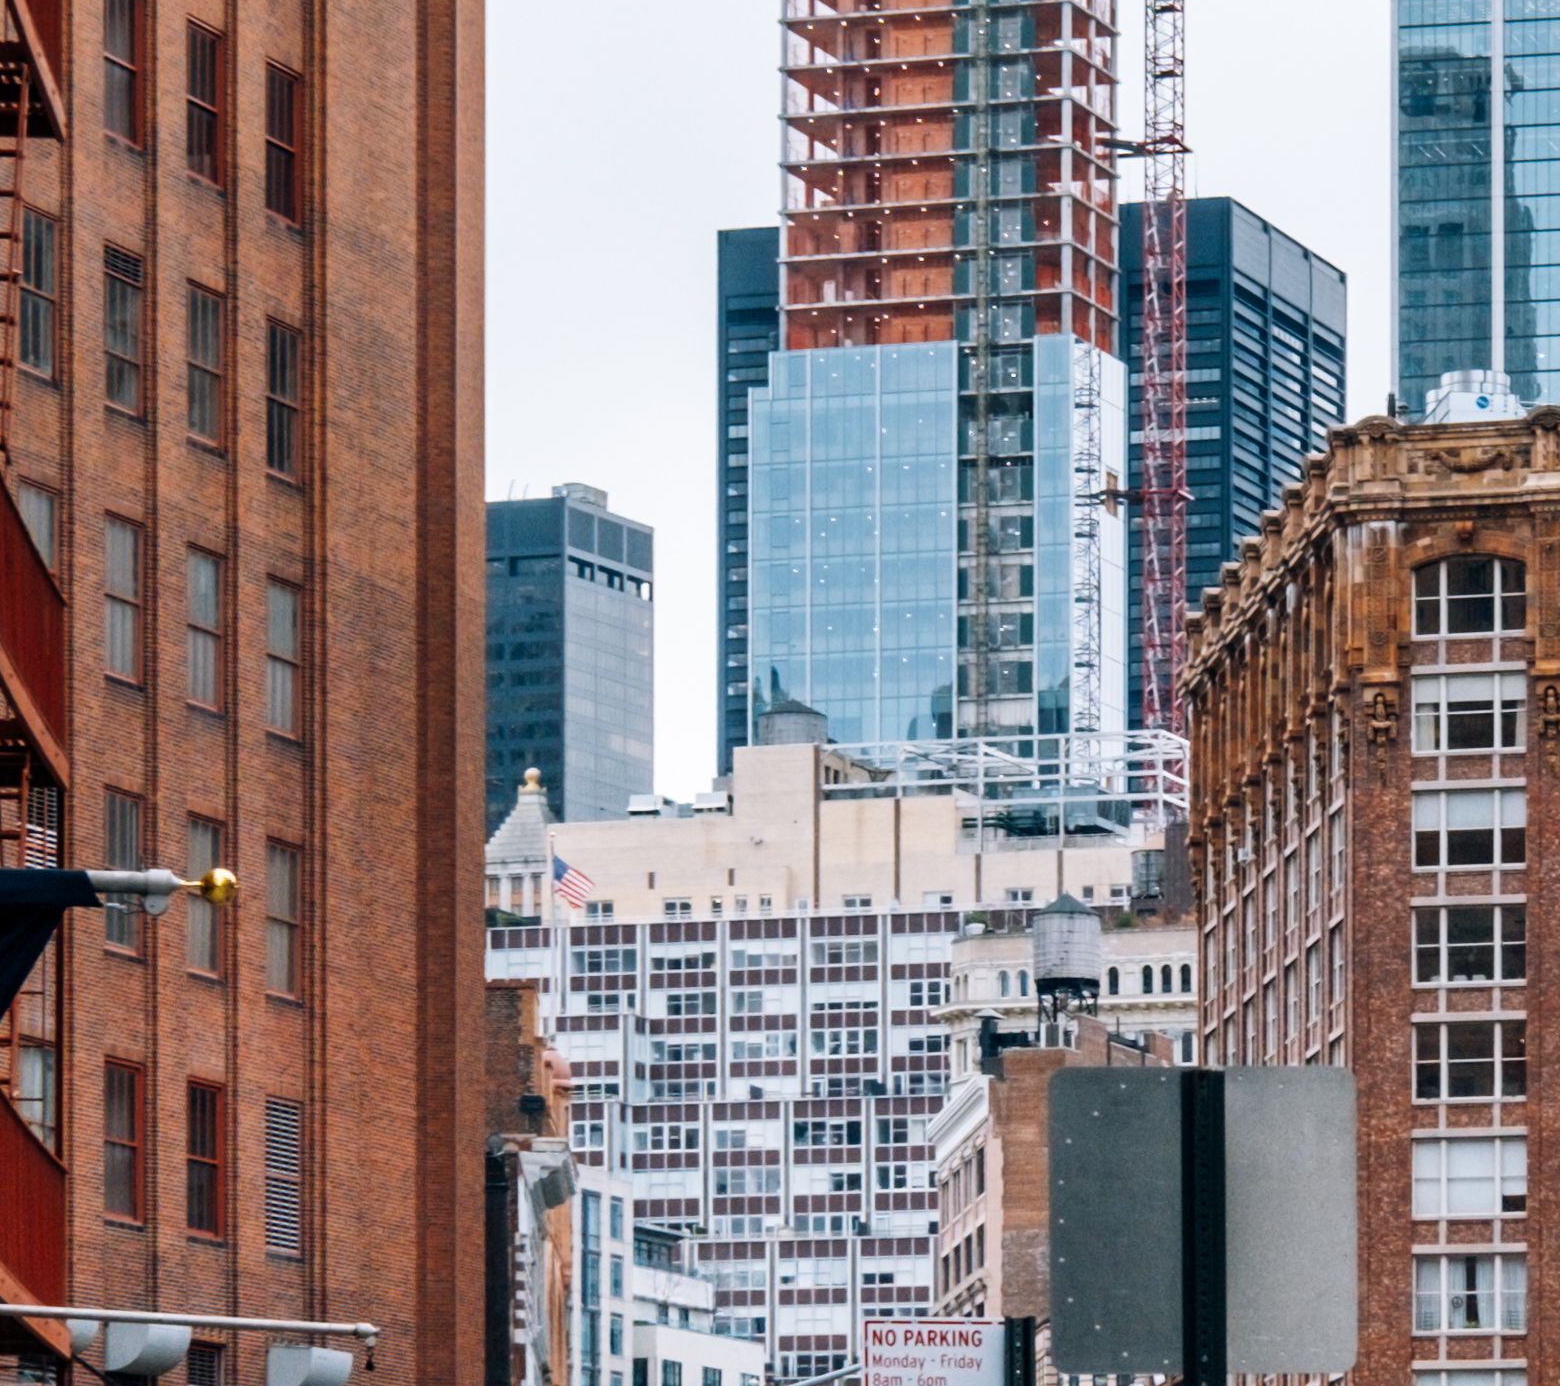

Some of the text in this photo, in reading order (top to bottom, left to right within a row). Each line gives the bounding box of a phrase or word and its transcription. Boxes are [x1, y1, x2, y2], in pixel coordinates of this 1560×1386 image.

[872, 1329, 983, 1347] NO PARKING
[872, 1354, 926, 1370] Monday
[940, 1354, 983, 1370] Friday
[872, 1373, 903, 1386] 8am
